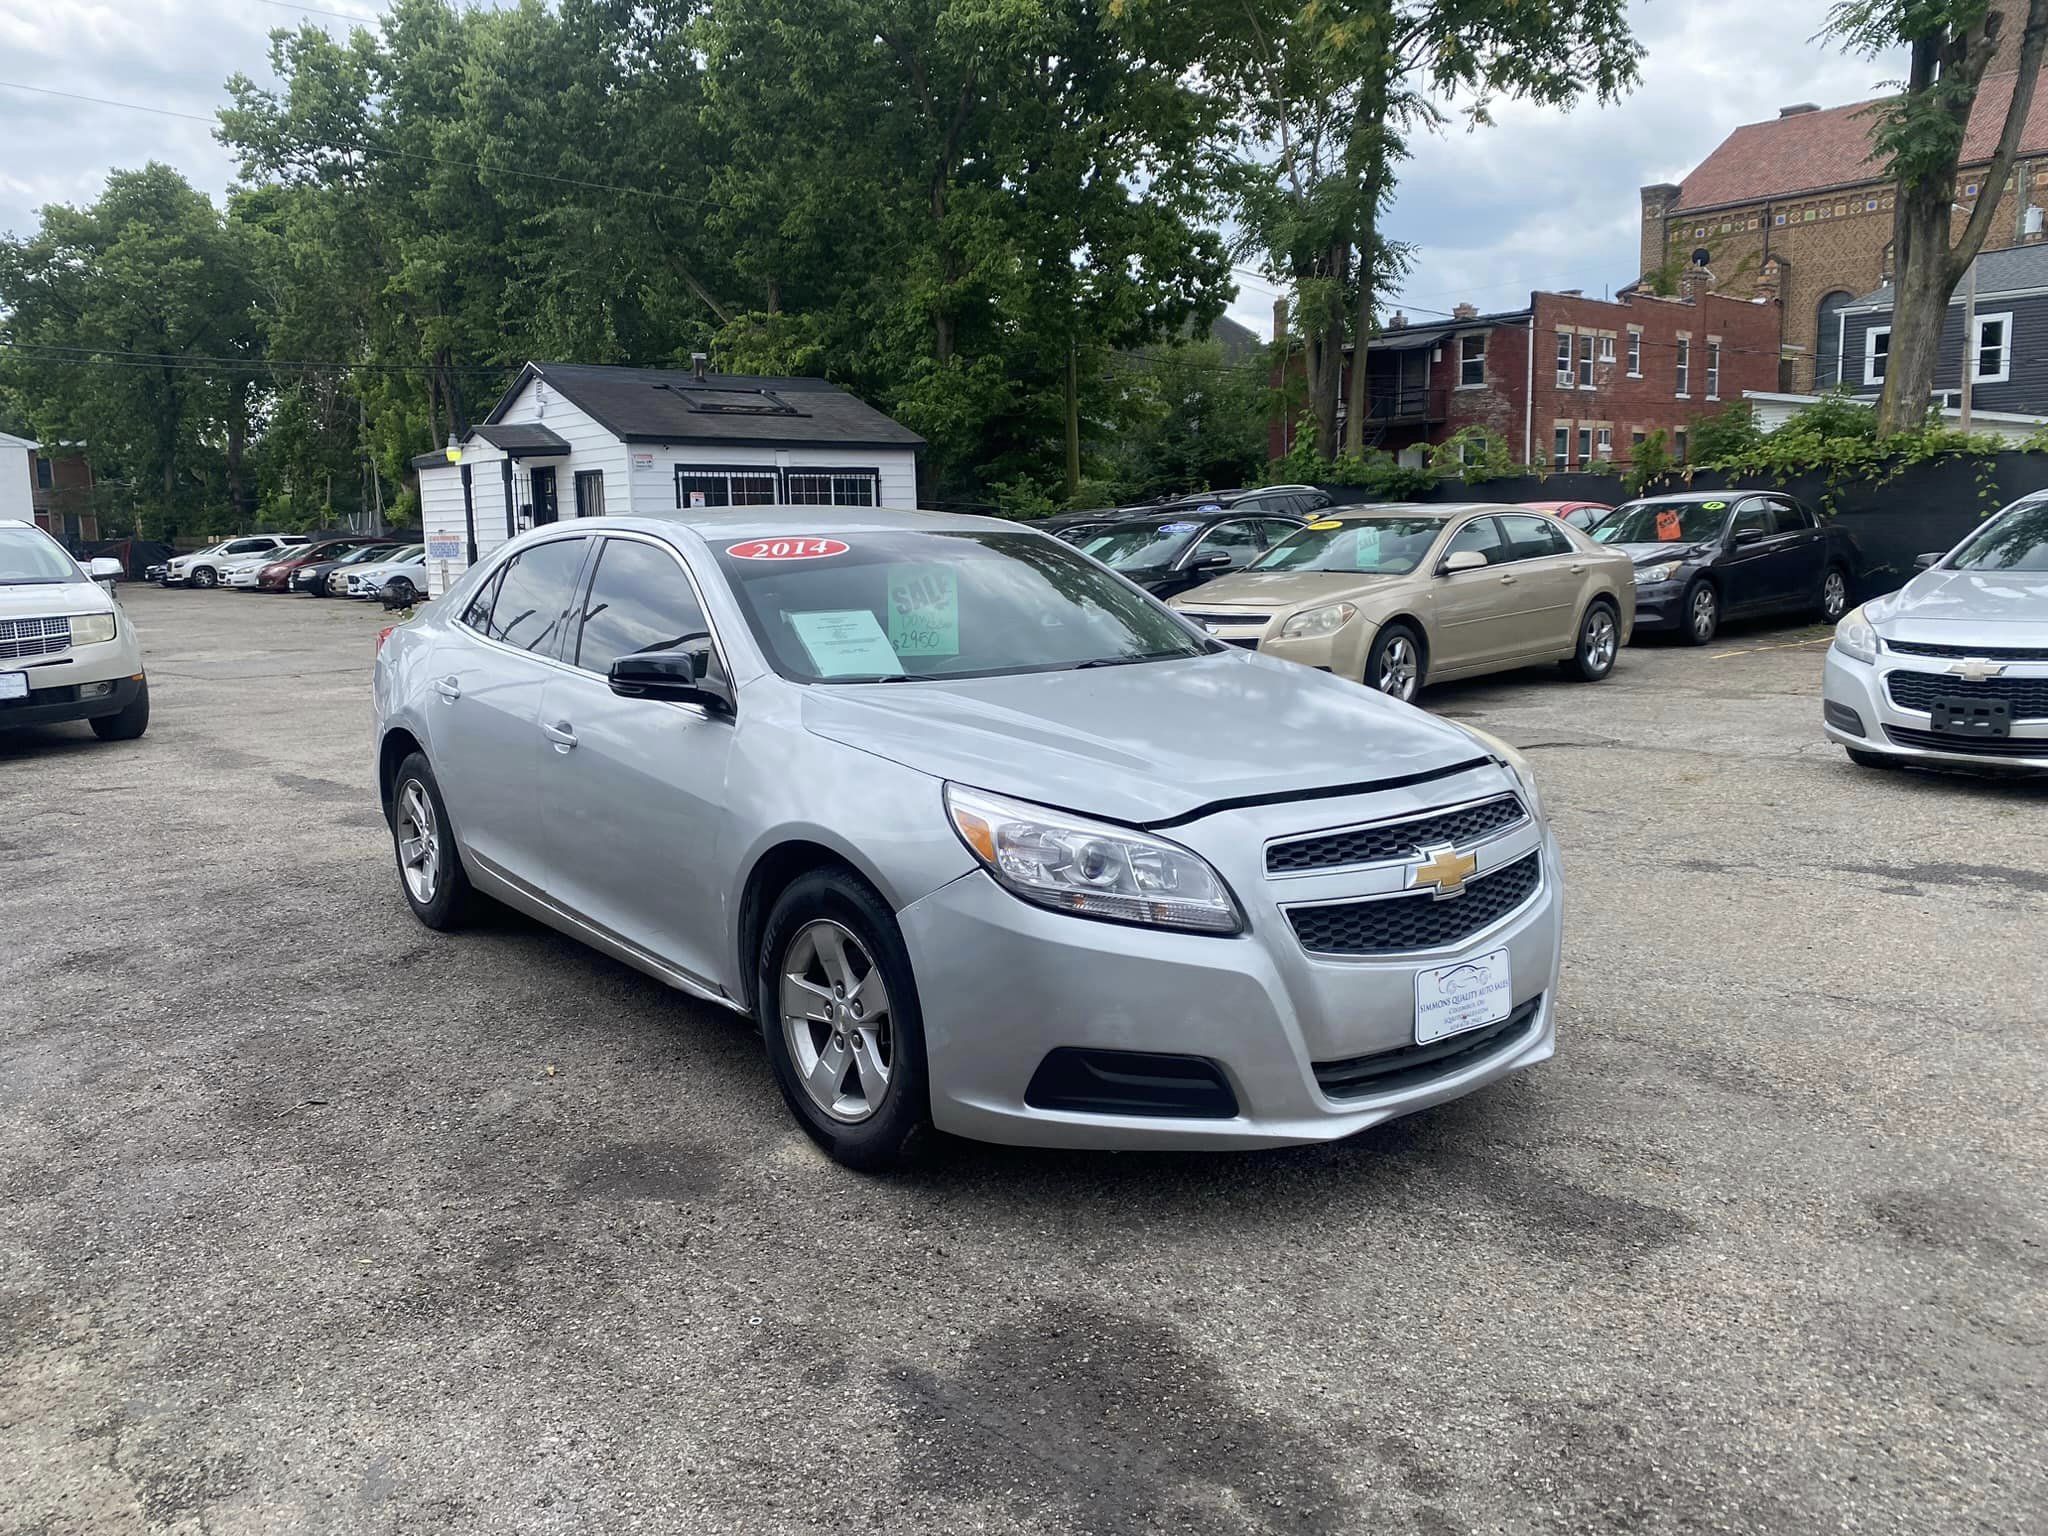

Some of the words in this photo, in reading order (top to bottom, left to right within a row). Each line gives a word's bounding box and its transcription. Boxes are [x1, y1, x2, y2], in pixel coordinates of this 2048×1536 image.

[751, 540, 828, 557] 2014
[892, 575, 952, 615] SALE
[1420, 998, 1451, 1013] SIMMONS
[1452, 991, 1477, 1004] QUALITY
[1479, 985, 1494, 996] AUTO
[1494, 980, 1509, 991] SALES
